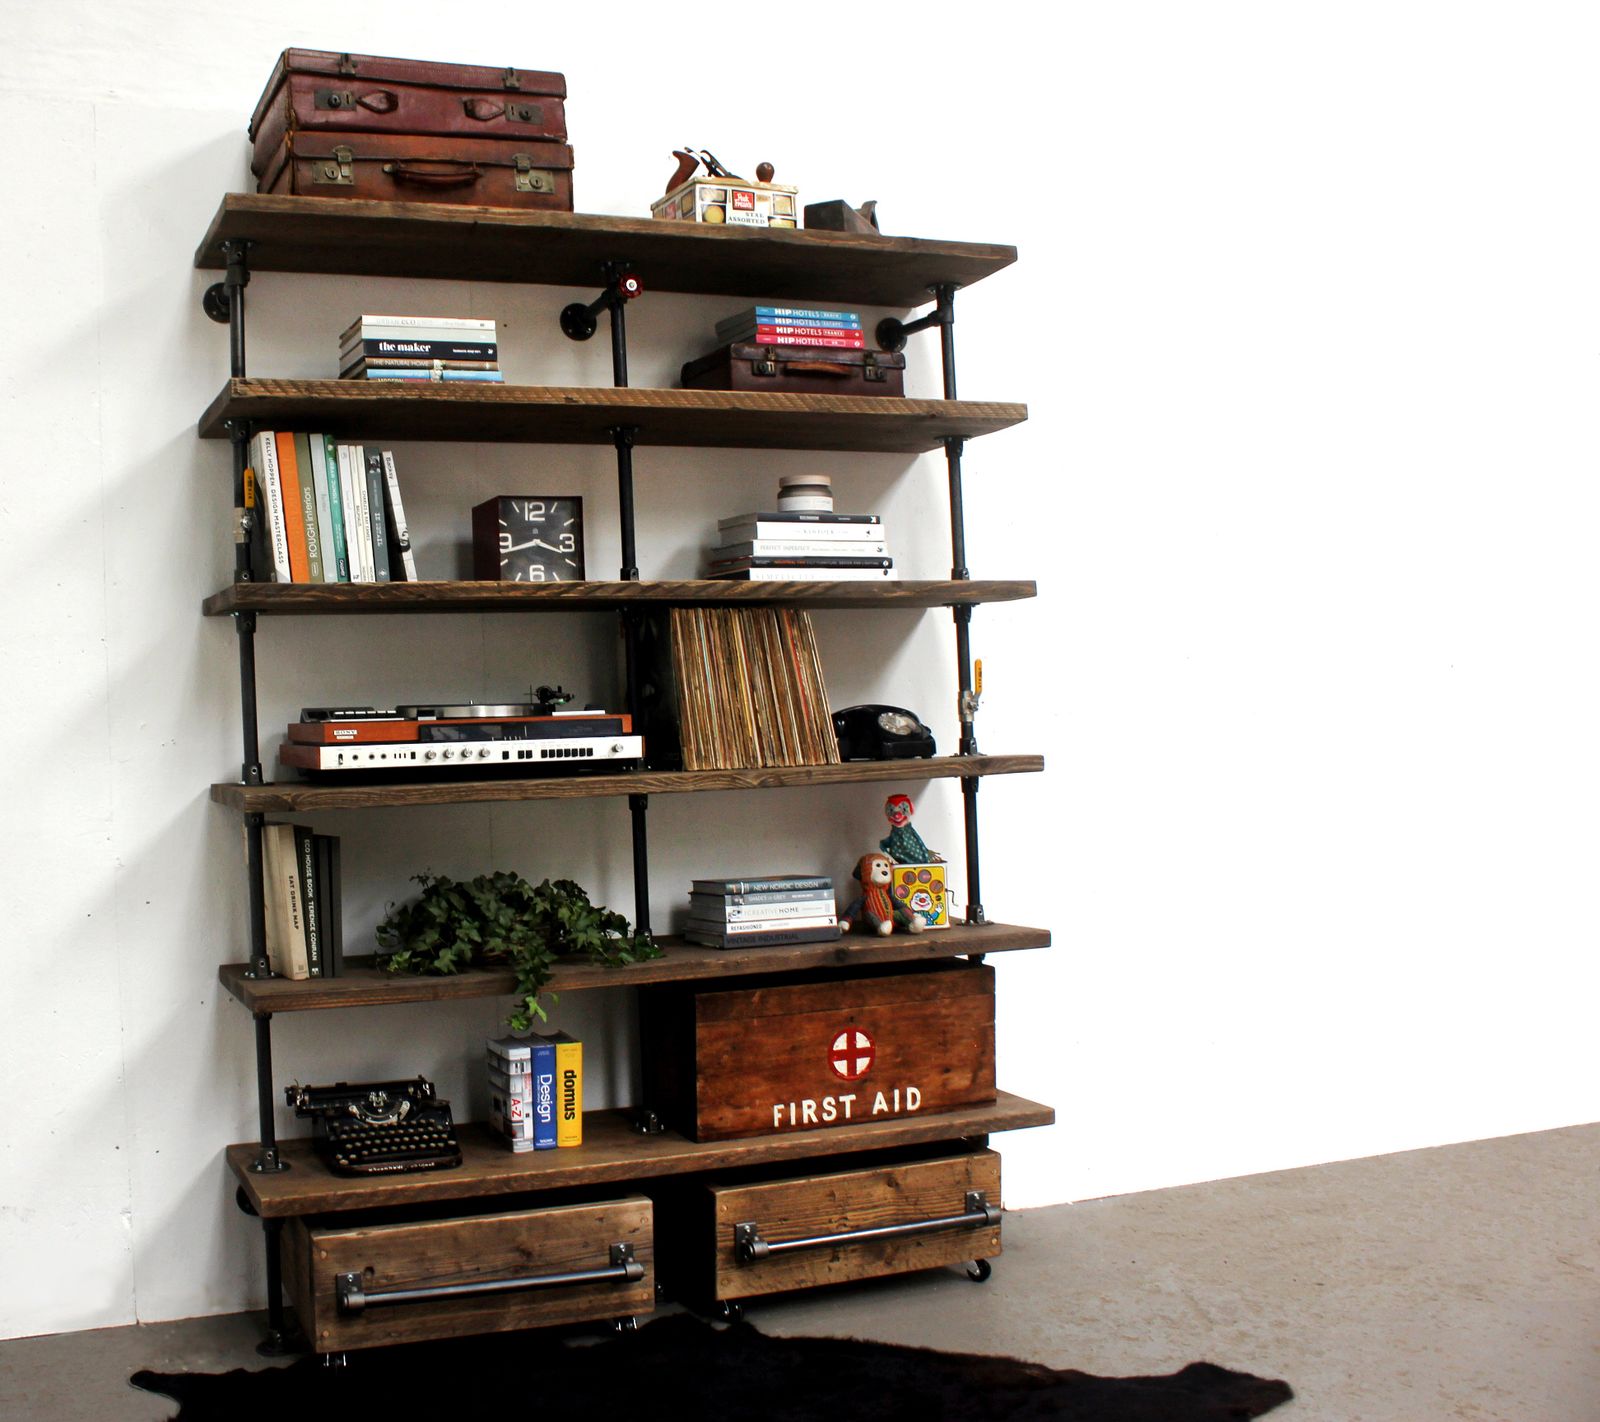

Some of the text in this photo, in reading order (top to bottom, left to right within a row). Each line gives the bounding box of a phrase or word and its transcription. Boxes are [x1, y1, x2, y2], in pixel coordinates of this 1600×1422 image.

[774, 308, 792, 316] HIP
[792, 310, 820, 318] HOTELS
[774, 317, 793, 325] HIP
[793, 319, 821, 327] HOTELS
[776, 326, 795, 334] HIP
[794, 328, 822, 336] HOTELS
[777, 336, 796, 344] HIP
[795, 337, 823, 346] HOTELS
[379, 341, 432, 353] the maker
[268, 458, 276, 486] HOPPEN
[274, 515, 284, 564] MASTERCLASS
[304, 487, 315, 523] interiors
[524, 501, 546, 522] 12
[308, 523, 318, 558] ROUGH
[559, 533, 575, 553] 3
[529, 564, 545, 582] 6
[753, 880, 819, 891] NEW NORDIC DESIGN
[289, 890, 297, 913] DRINK
[778, 906, 799, 914] HOME
[308, 901, 316, 932] TERENCE
[310, 933, 318, 961] CONRAN
[537, 1074, 553, 1123] Design
[563, 1069, 577, 1121] domus
[511, 1098, 522, 1118] A-Z
[773, 1086, 921, 1127] FIRST AID
